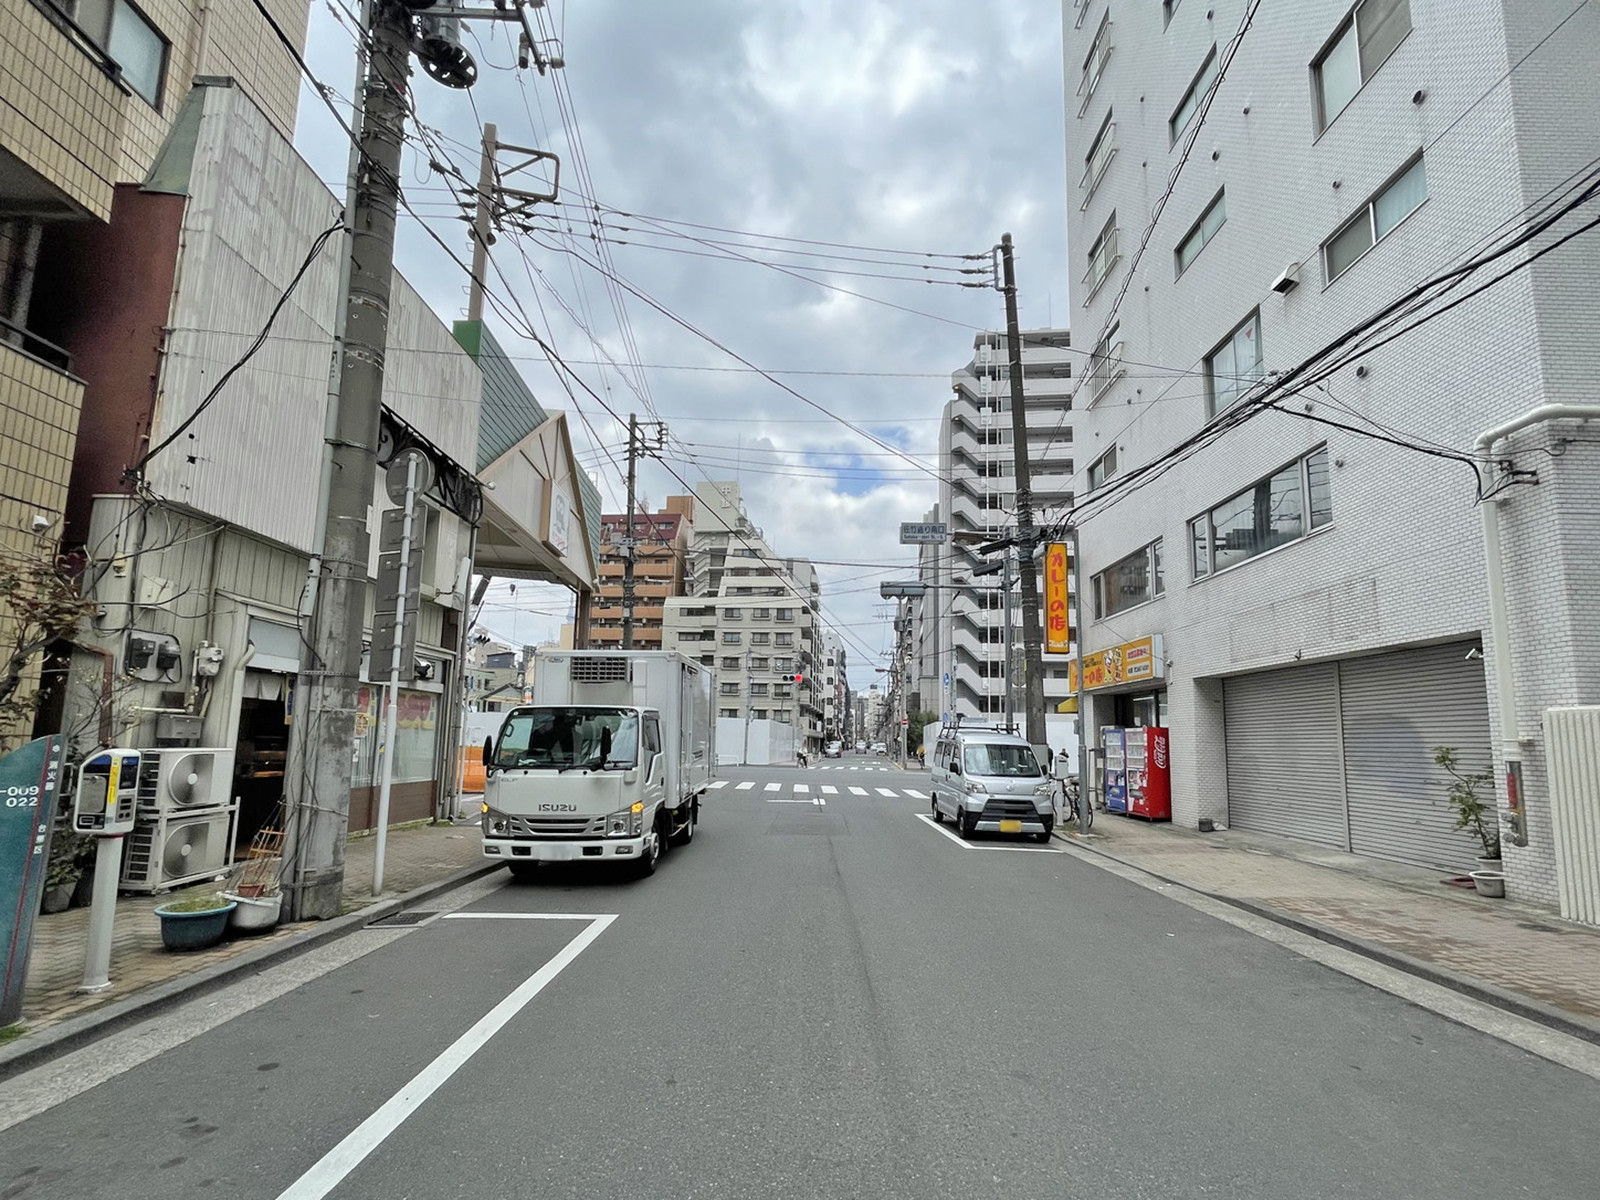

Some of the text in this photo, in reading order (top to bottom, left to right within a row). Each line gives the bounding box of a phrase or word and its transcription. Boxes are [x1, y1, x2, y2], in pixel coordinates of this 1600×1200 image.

[1050, 553, 1066, 632] カレーの店
[6, 797, 38, 807] 022
[538, 803, 578, 813] ISUZU
